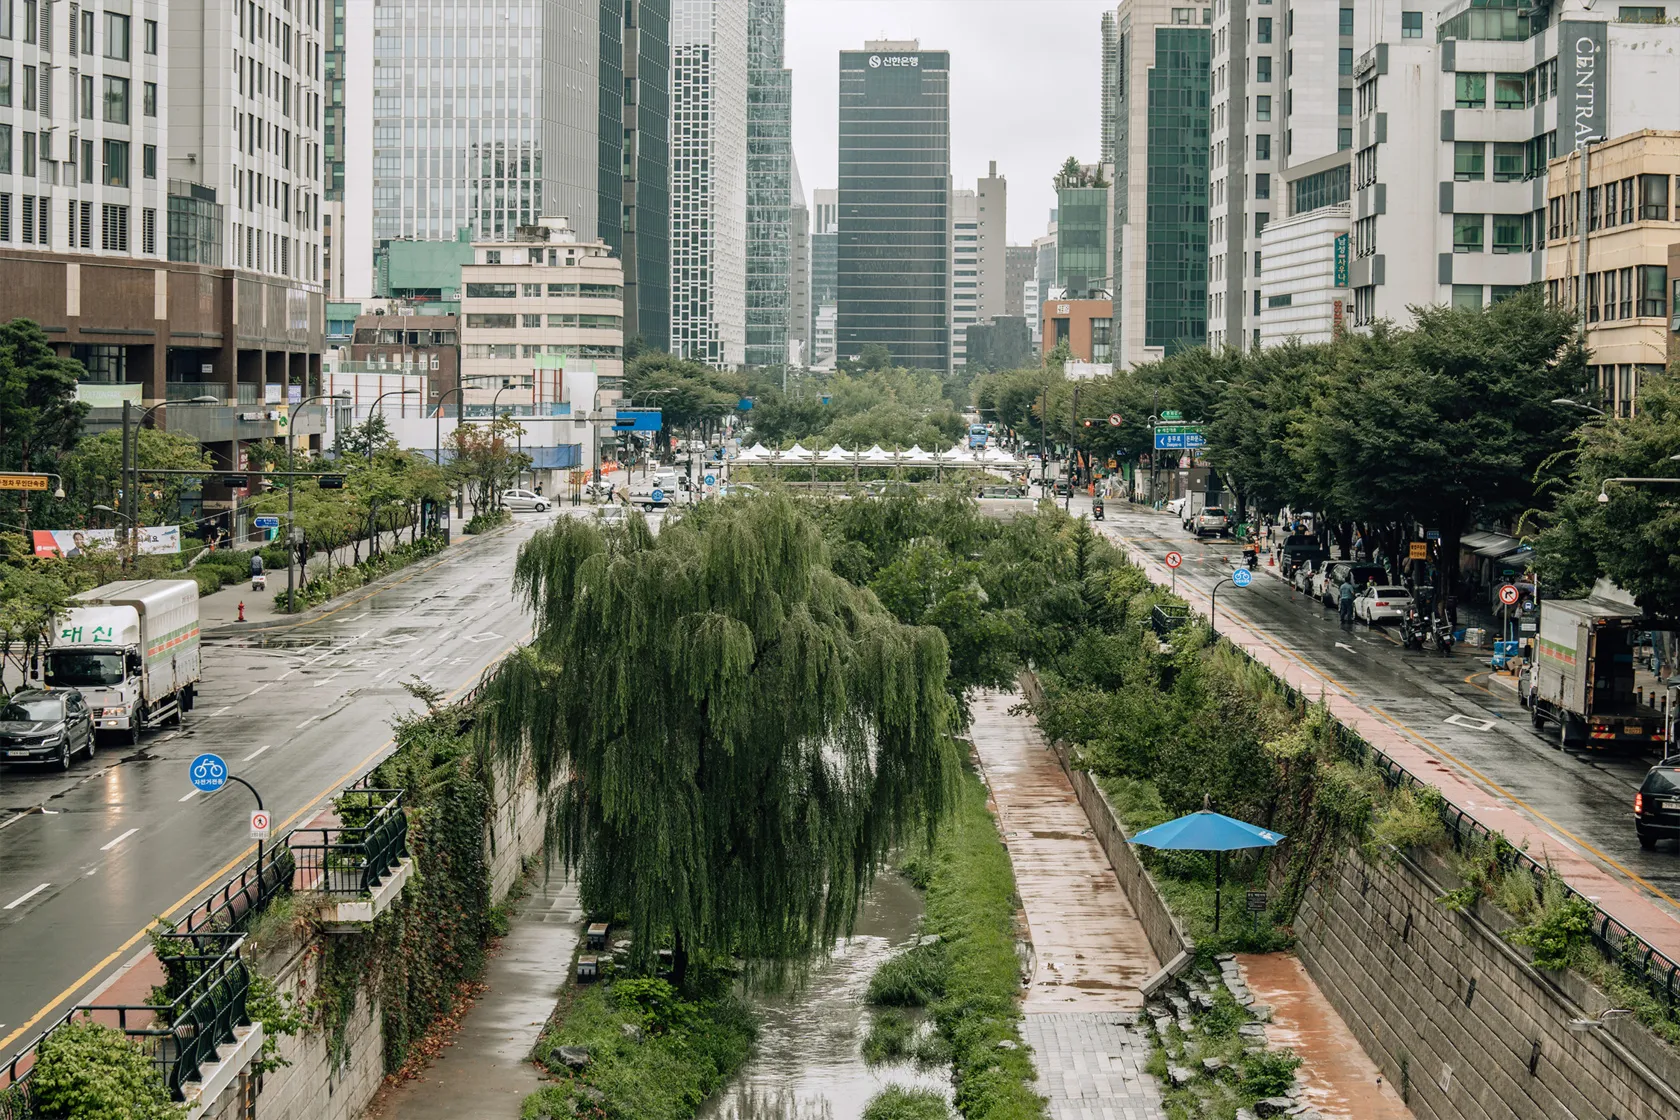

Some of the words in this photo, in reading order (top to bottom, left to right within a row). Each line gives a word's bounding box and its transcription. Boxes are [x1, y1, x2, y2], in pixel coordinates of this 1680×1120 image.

[882, 56, 919, 67] 신한은행
[1337, 237, 1346, 255] 남성
[1337, 258, 1346, 281] 사우나
[0, 479, 14, 487] 정차
[15, 479, 45, 488] 무인단속중
[61, 625, 113, 643] 대신
[194, 778, 223, 786] 자전거전용
